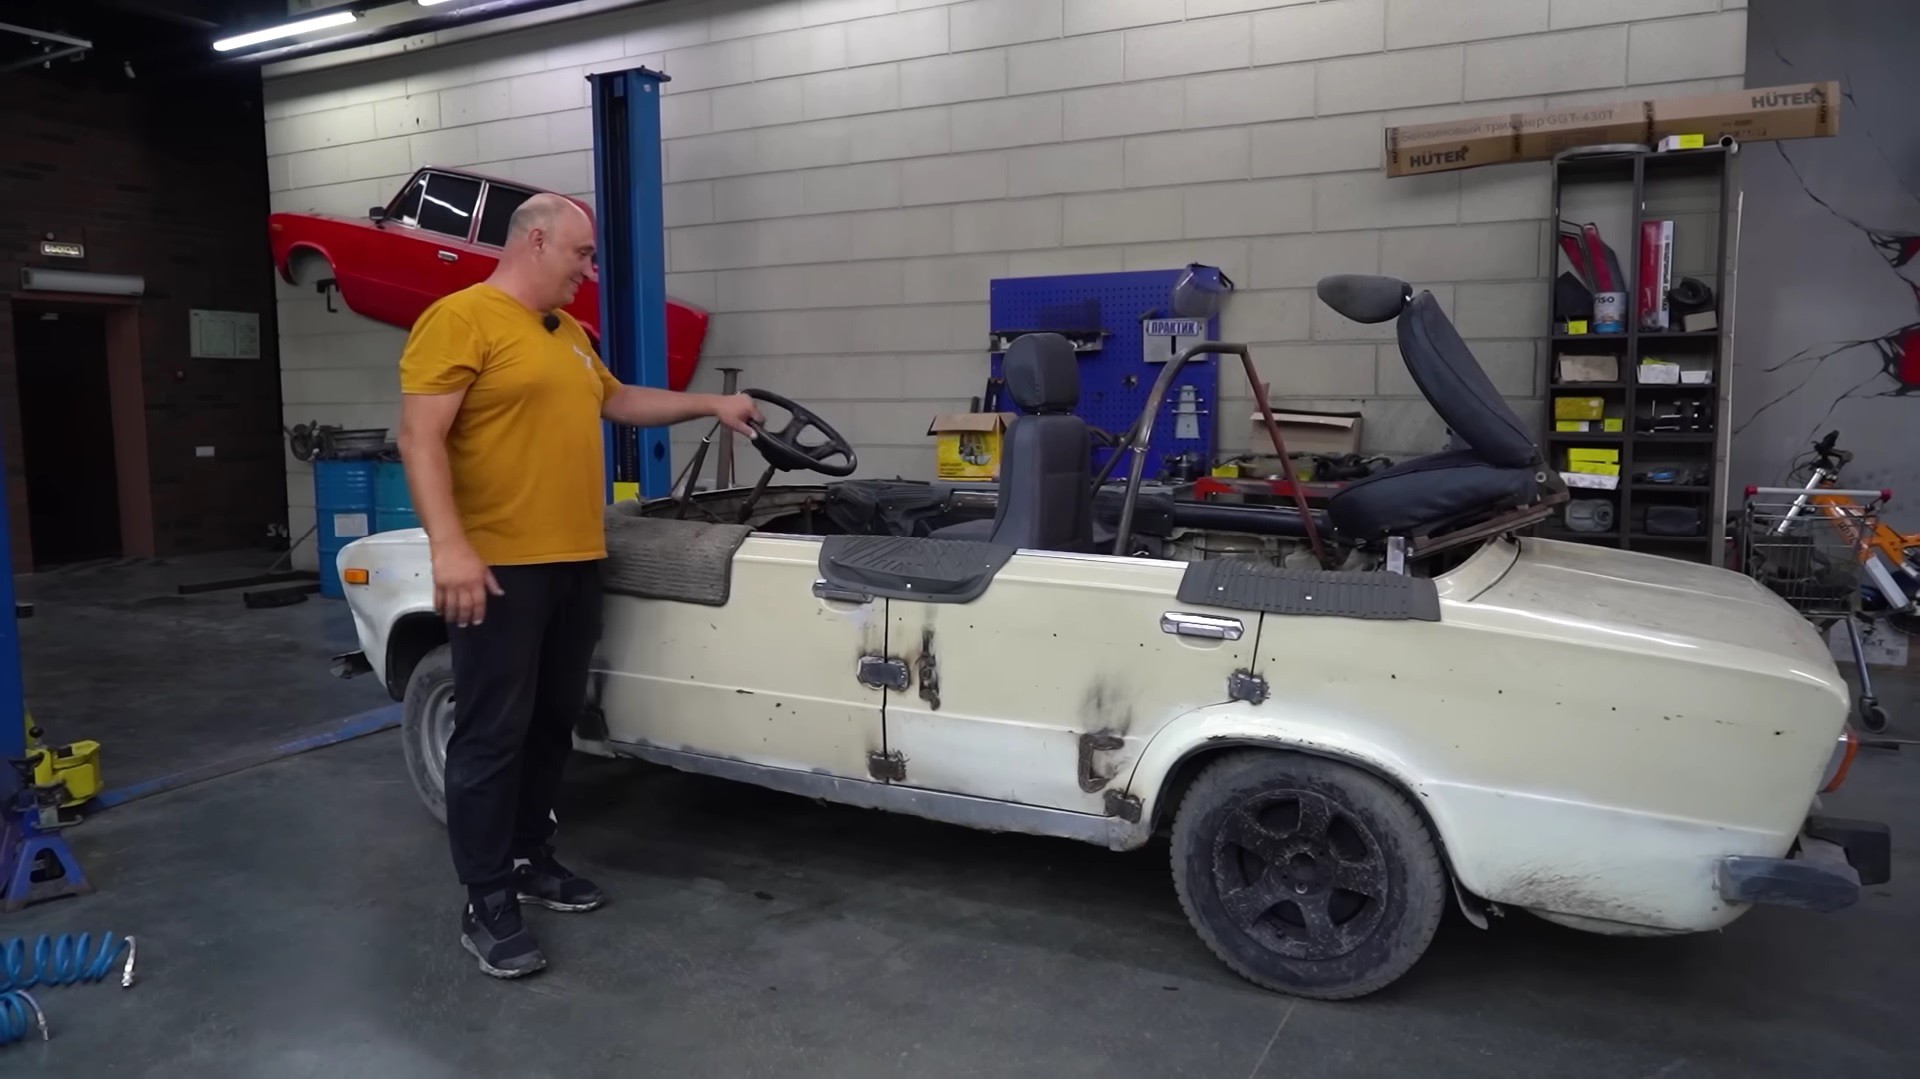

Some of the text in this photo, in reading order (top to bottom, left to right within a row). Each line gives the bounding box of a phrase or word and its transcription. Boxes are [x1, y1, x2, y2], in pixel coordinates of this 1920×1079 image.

[1751, 91, 1818, 108] HÜTER
[1410, 150, 1467, 168] HÜTER
[1152, 321, 1195, 335] ПРАКТИК
